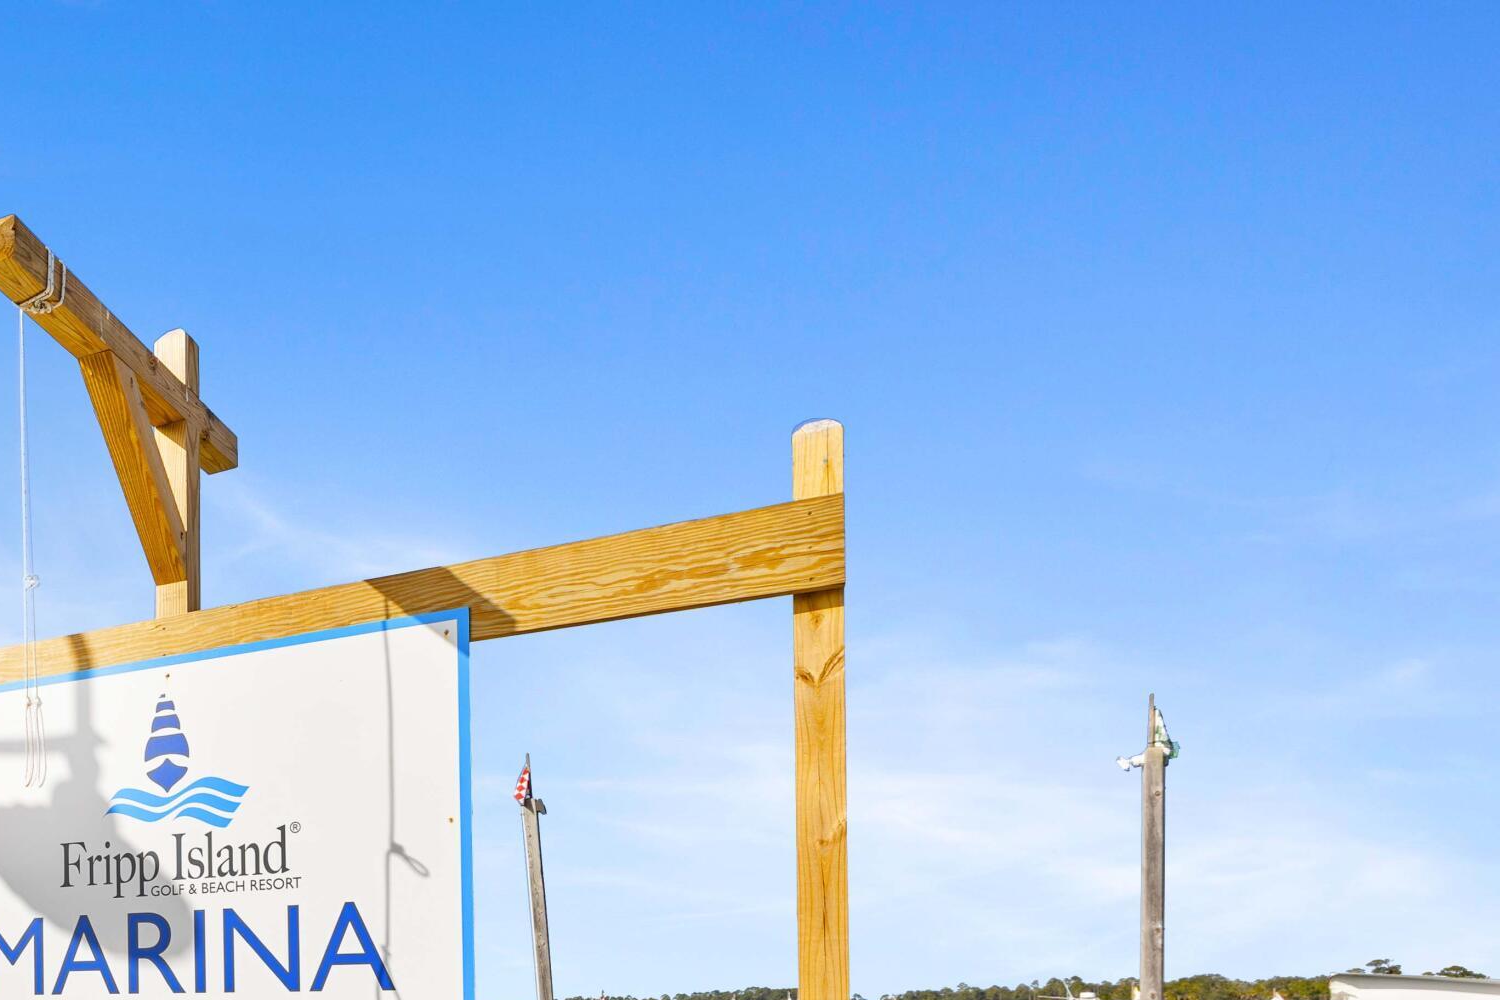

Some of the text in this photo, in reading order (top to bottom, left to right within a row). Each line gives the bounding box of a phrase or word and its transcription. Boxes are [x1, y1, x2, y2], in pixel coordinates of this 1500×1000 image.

[60, 841, 160, 898] Fripp
[150, 876, 302, 897] GOLF & BEACH RESORT
